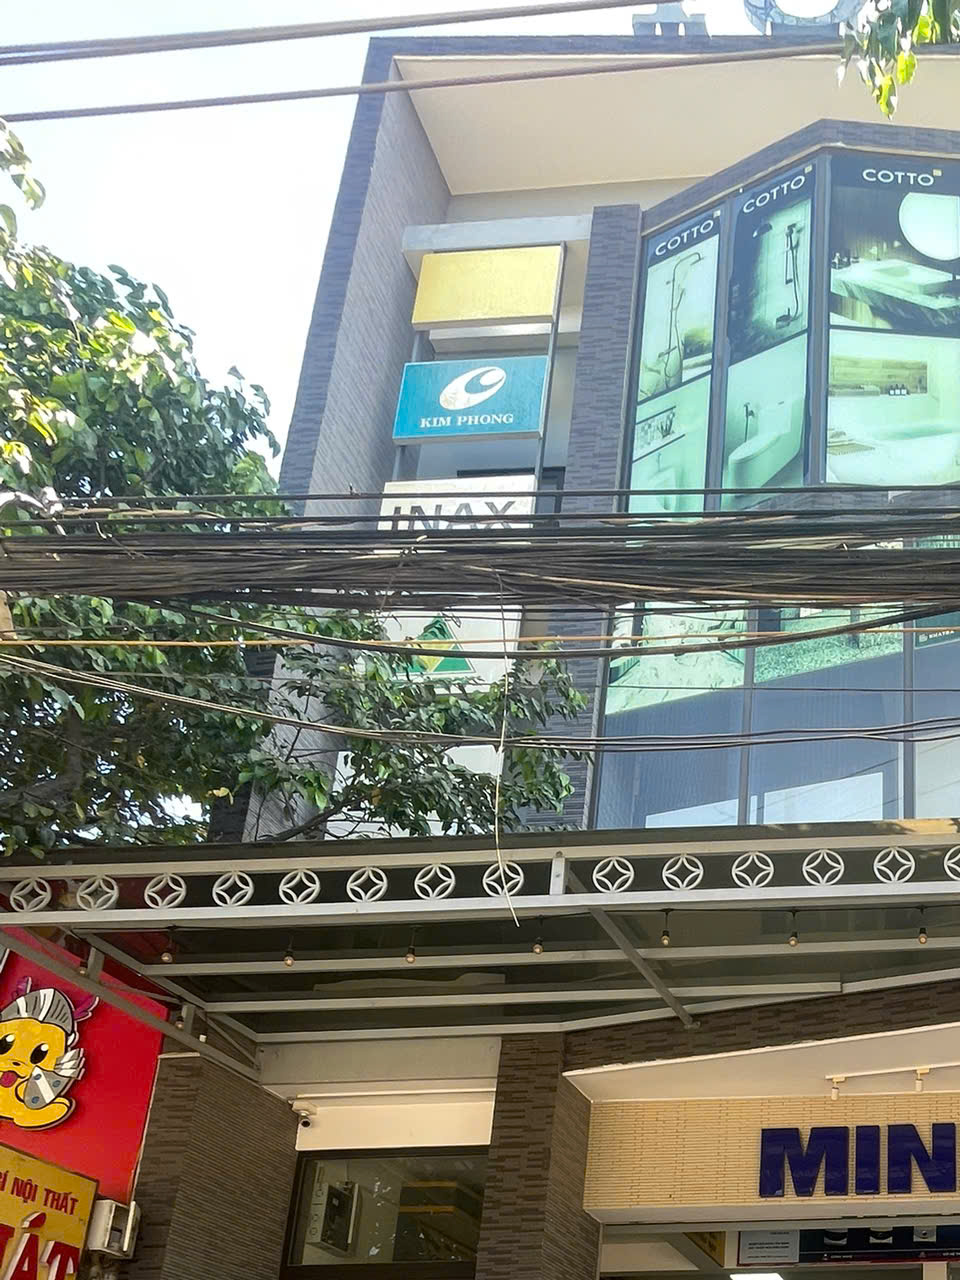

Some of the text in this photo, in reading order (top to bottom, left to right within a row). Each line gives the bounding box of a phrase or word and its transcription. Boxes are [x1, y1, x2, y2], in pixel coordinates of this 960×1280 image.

[743, 174, 807, 215] COTTO
[862, 168, 935, 187] COTTO
[654, 219, 715, 257] COTTO
[420, 412, 514, 428] KIM PHONG
[391, 500, 516, 531] INAX
[11, 1176, 39, 1204] NỘI
[43, 1187, 79, 1216] THẤT
